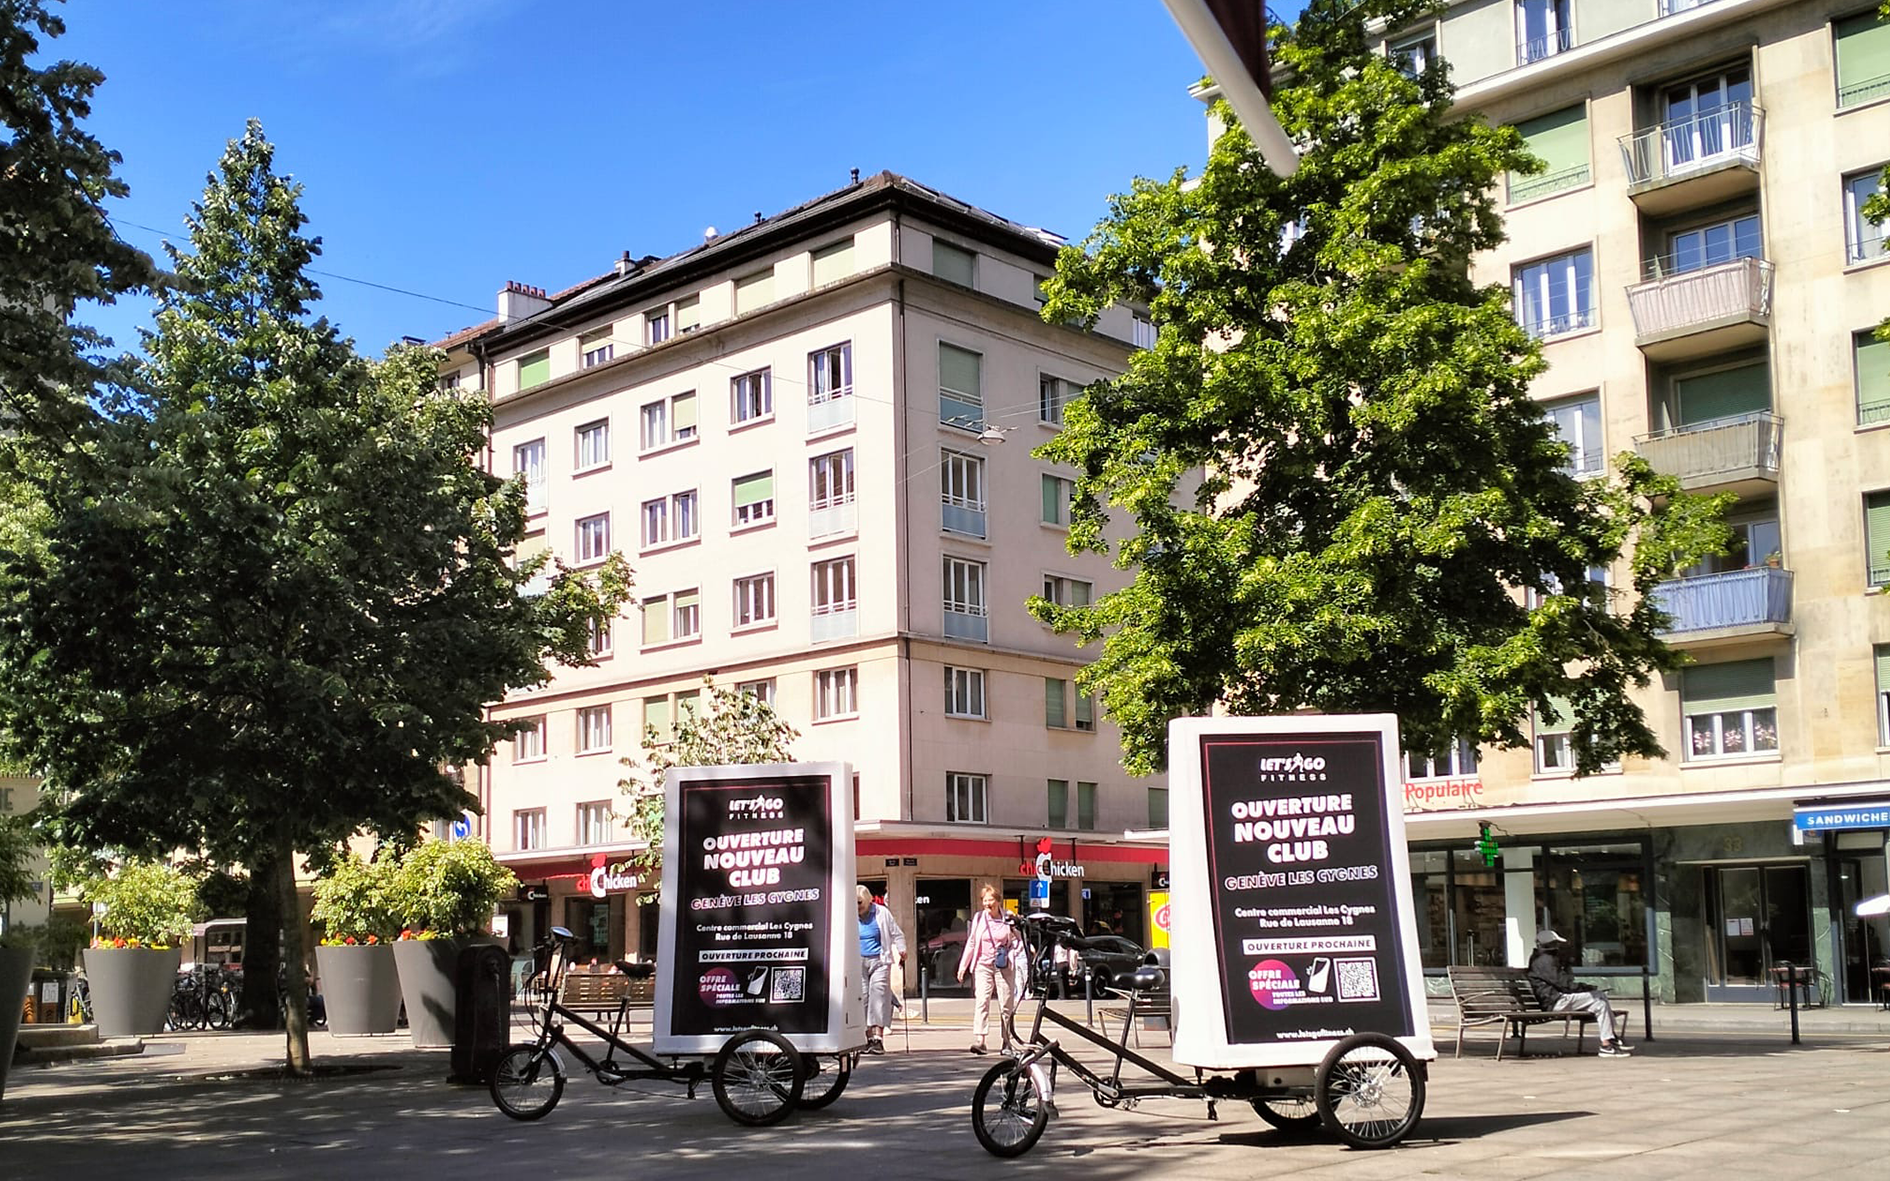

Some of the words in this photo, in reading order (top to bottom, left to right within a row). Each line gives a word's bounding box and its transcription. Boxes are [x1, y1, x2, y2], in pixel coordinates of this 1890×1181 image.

[1260, 758, 1292, 771] LET'S
[1303, 756, 1326, 771] GO
[1260, 772, 1327, 782] FITNESS
[1404, 779, 1483, 802] Populaire
[729, 799, 755, 811] LET'S
[765, 798, 784, 810] GO
[1231, 793, 1352, 819] OUVERTURE
[729, 810, 784, 820] FITNESS
[1807, 812, 1890, 825] SANDWICHE
[1234, 814, 1355, 842] NOUVEAU
[703, 828, 804, 851] OUVERTURE
[704, 846, 805, 870] NOUVEAU
[1266, 840, 1329, 864] CLUB
[728, 868, 781, 888] CLUB
[1224, 870, 1286, 891] GENÈVE
[1288, 870, 1315, 885] LES
[1316, 866, 1378, 883] CYGNES
[690, 892, 742, 910] GENÈVE
[743, 892, 766, 906] LES
[768, 888, 820, 904] CYGNES
[1235, 908, 1266, 918] Centre
[1267, 906, 1322, 916] commercial
[1324, 906, 1340, 915] Les
[1340, 905, 1376, 917] Cygnes
[696, 924, 722, 932] Centre
[723, 922, 768, 931] commercial
[784, 922, 813, 932] Cygnes
[1260, 918, 1278, 928] Rue
[1280, 917, 1292, 927] de
[1294, 916, 1340, 926] Lausanne
[1342, 916, 1354, 926] 18
[715, 933, 731, 941] Rue
[732, 932, 742, 940] de
[744, 932, 782, 940] Lausanne
[1247, 940, 1308, 952] OUVERTURE
[1311, 939, 1372, 950] PROCHAINE
[702, 950, 752, 960] OUVERTURE
[754, 950, 806, 959] PROCHAINE
[700, 975, 727, 984] OFFRE
[1248, 970, 1282, 980] OFFRE
[700, 982, 740, 992] SPÉCIALE
[1252, 978, 1300, 990] SPÉCIALE
